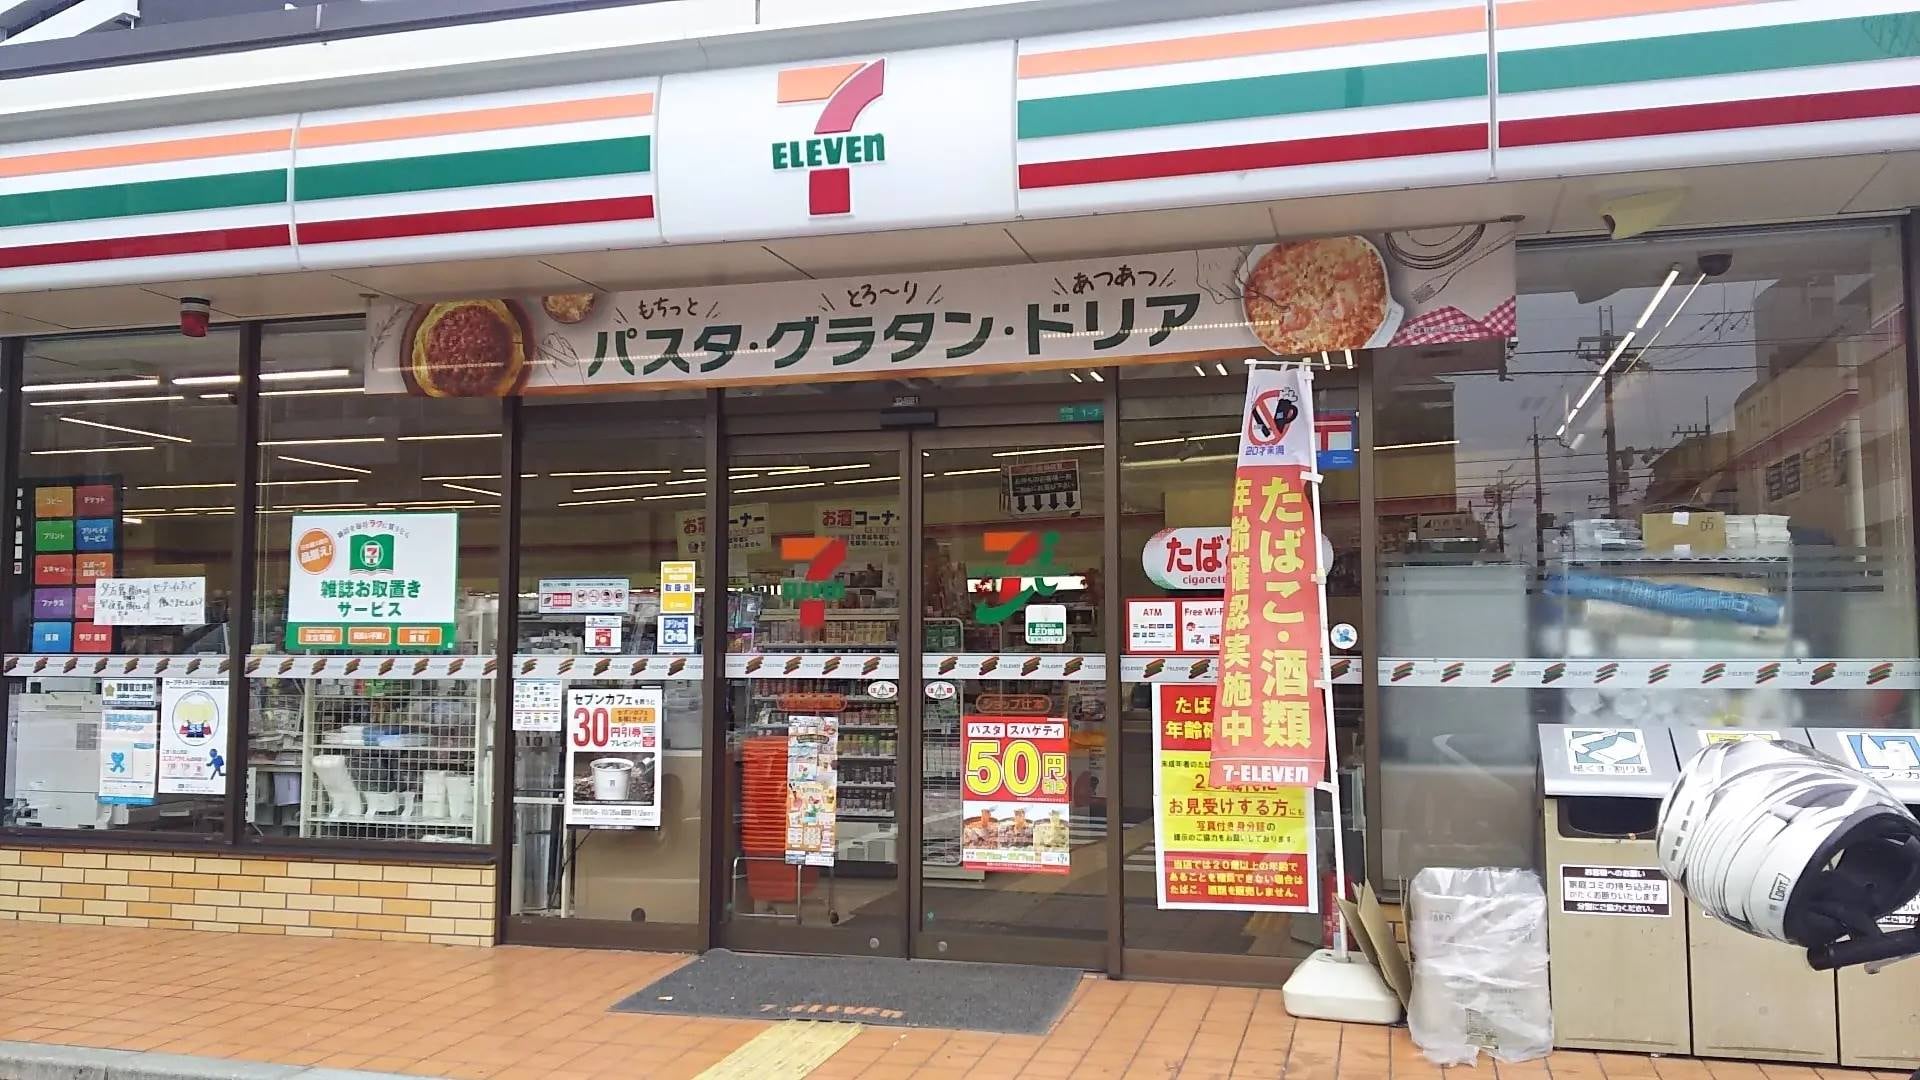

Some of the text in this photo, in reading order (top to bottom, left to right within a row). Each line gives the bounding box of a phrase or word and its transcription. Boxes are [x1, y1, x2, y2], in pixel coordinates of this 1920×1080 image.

[1073, 264, 1157, 294] あつあつ
[638, 297, 699, 320] もちっと
[588, 293, 1200, 377] パスタ・グラタン・ドリア
[1166, 536, 1229, 573] たば
[320, 580, 421, 598] 雑誌お取置き
[338, 602, 402, 617] サービス
[1143, 608, 1162, 616] ATM
[1184, 607, 1223, 616] Free Wi-F
[573, 707, 609, 747] 30
